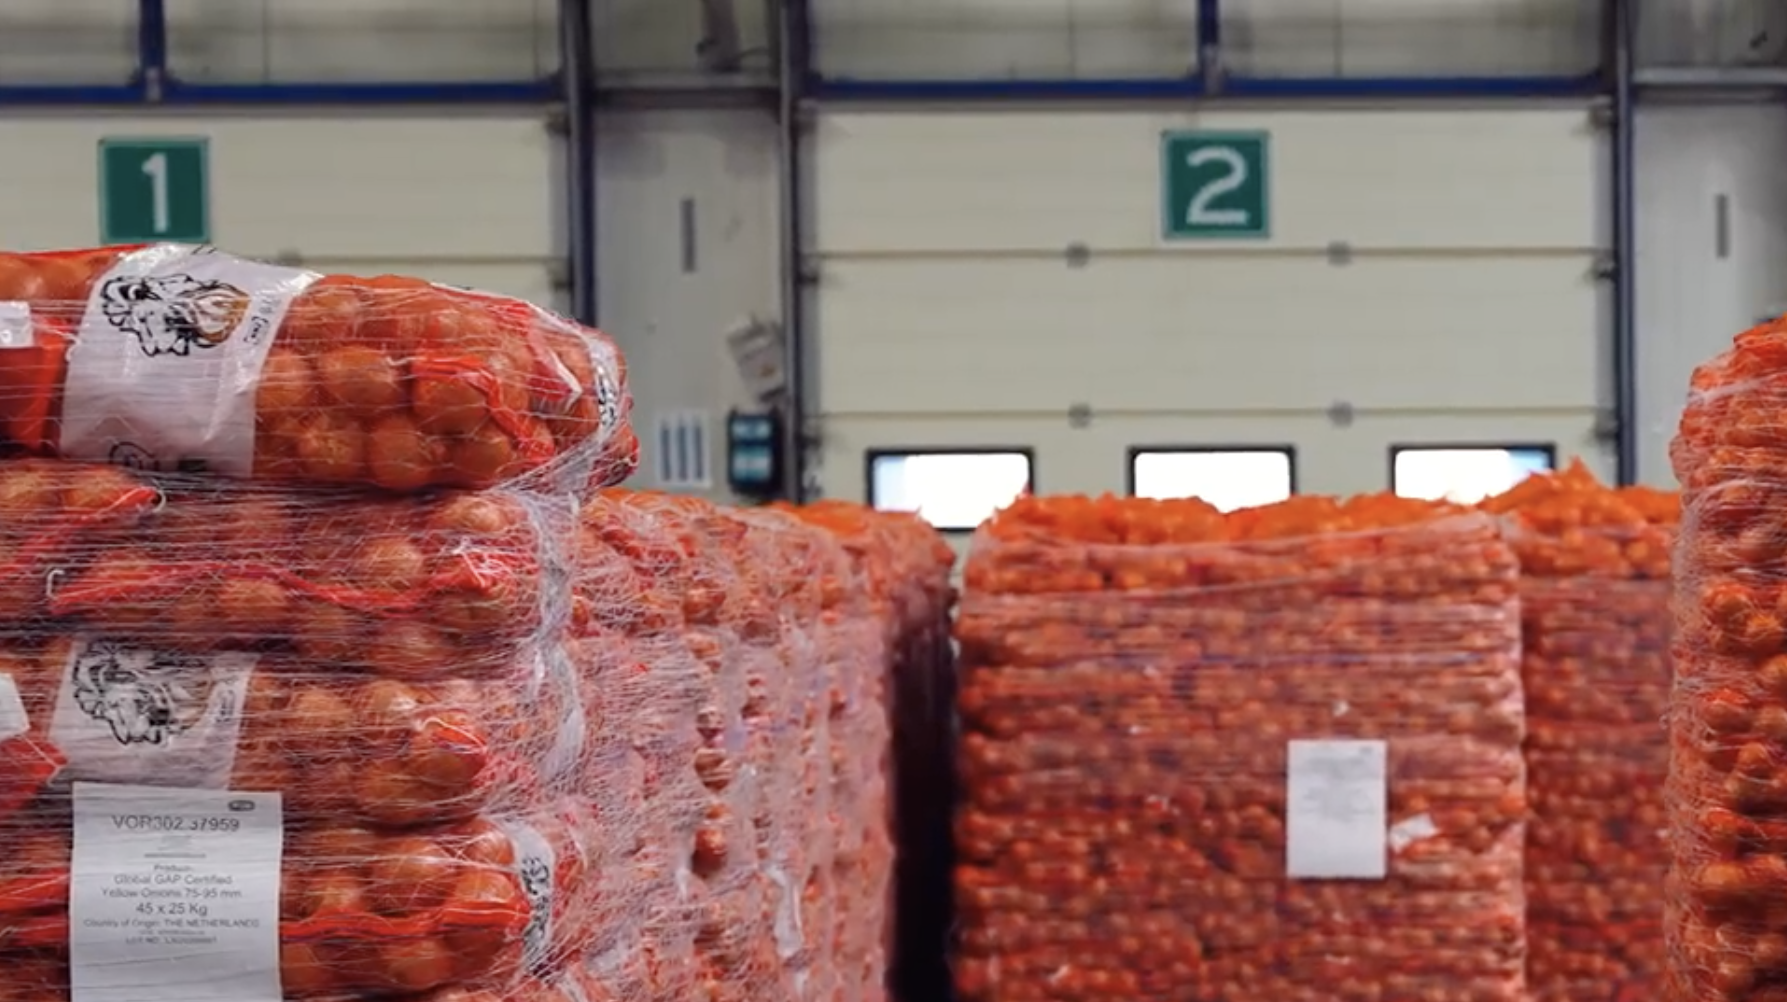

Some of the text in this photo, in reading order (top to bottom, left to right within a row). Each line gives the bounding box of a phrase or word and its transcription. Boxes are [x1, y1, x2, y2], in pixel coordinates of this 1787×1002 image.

[1185, 145, 1250, 226] 2
[140, 151, 171, 235] 1
[114, 874, 233, 885] Global GAP Certified
[102, 888, 138, 898] Yellow
[141, 888, 182, 898] Onions
[219, 889, 242, 898] mm
[136, 903, 208, 917] 45 x 25 Kg
